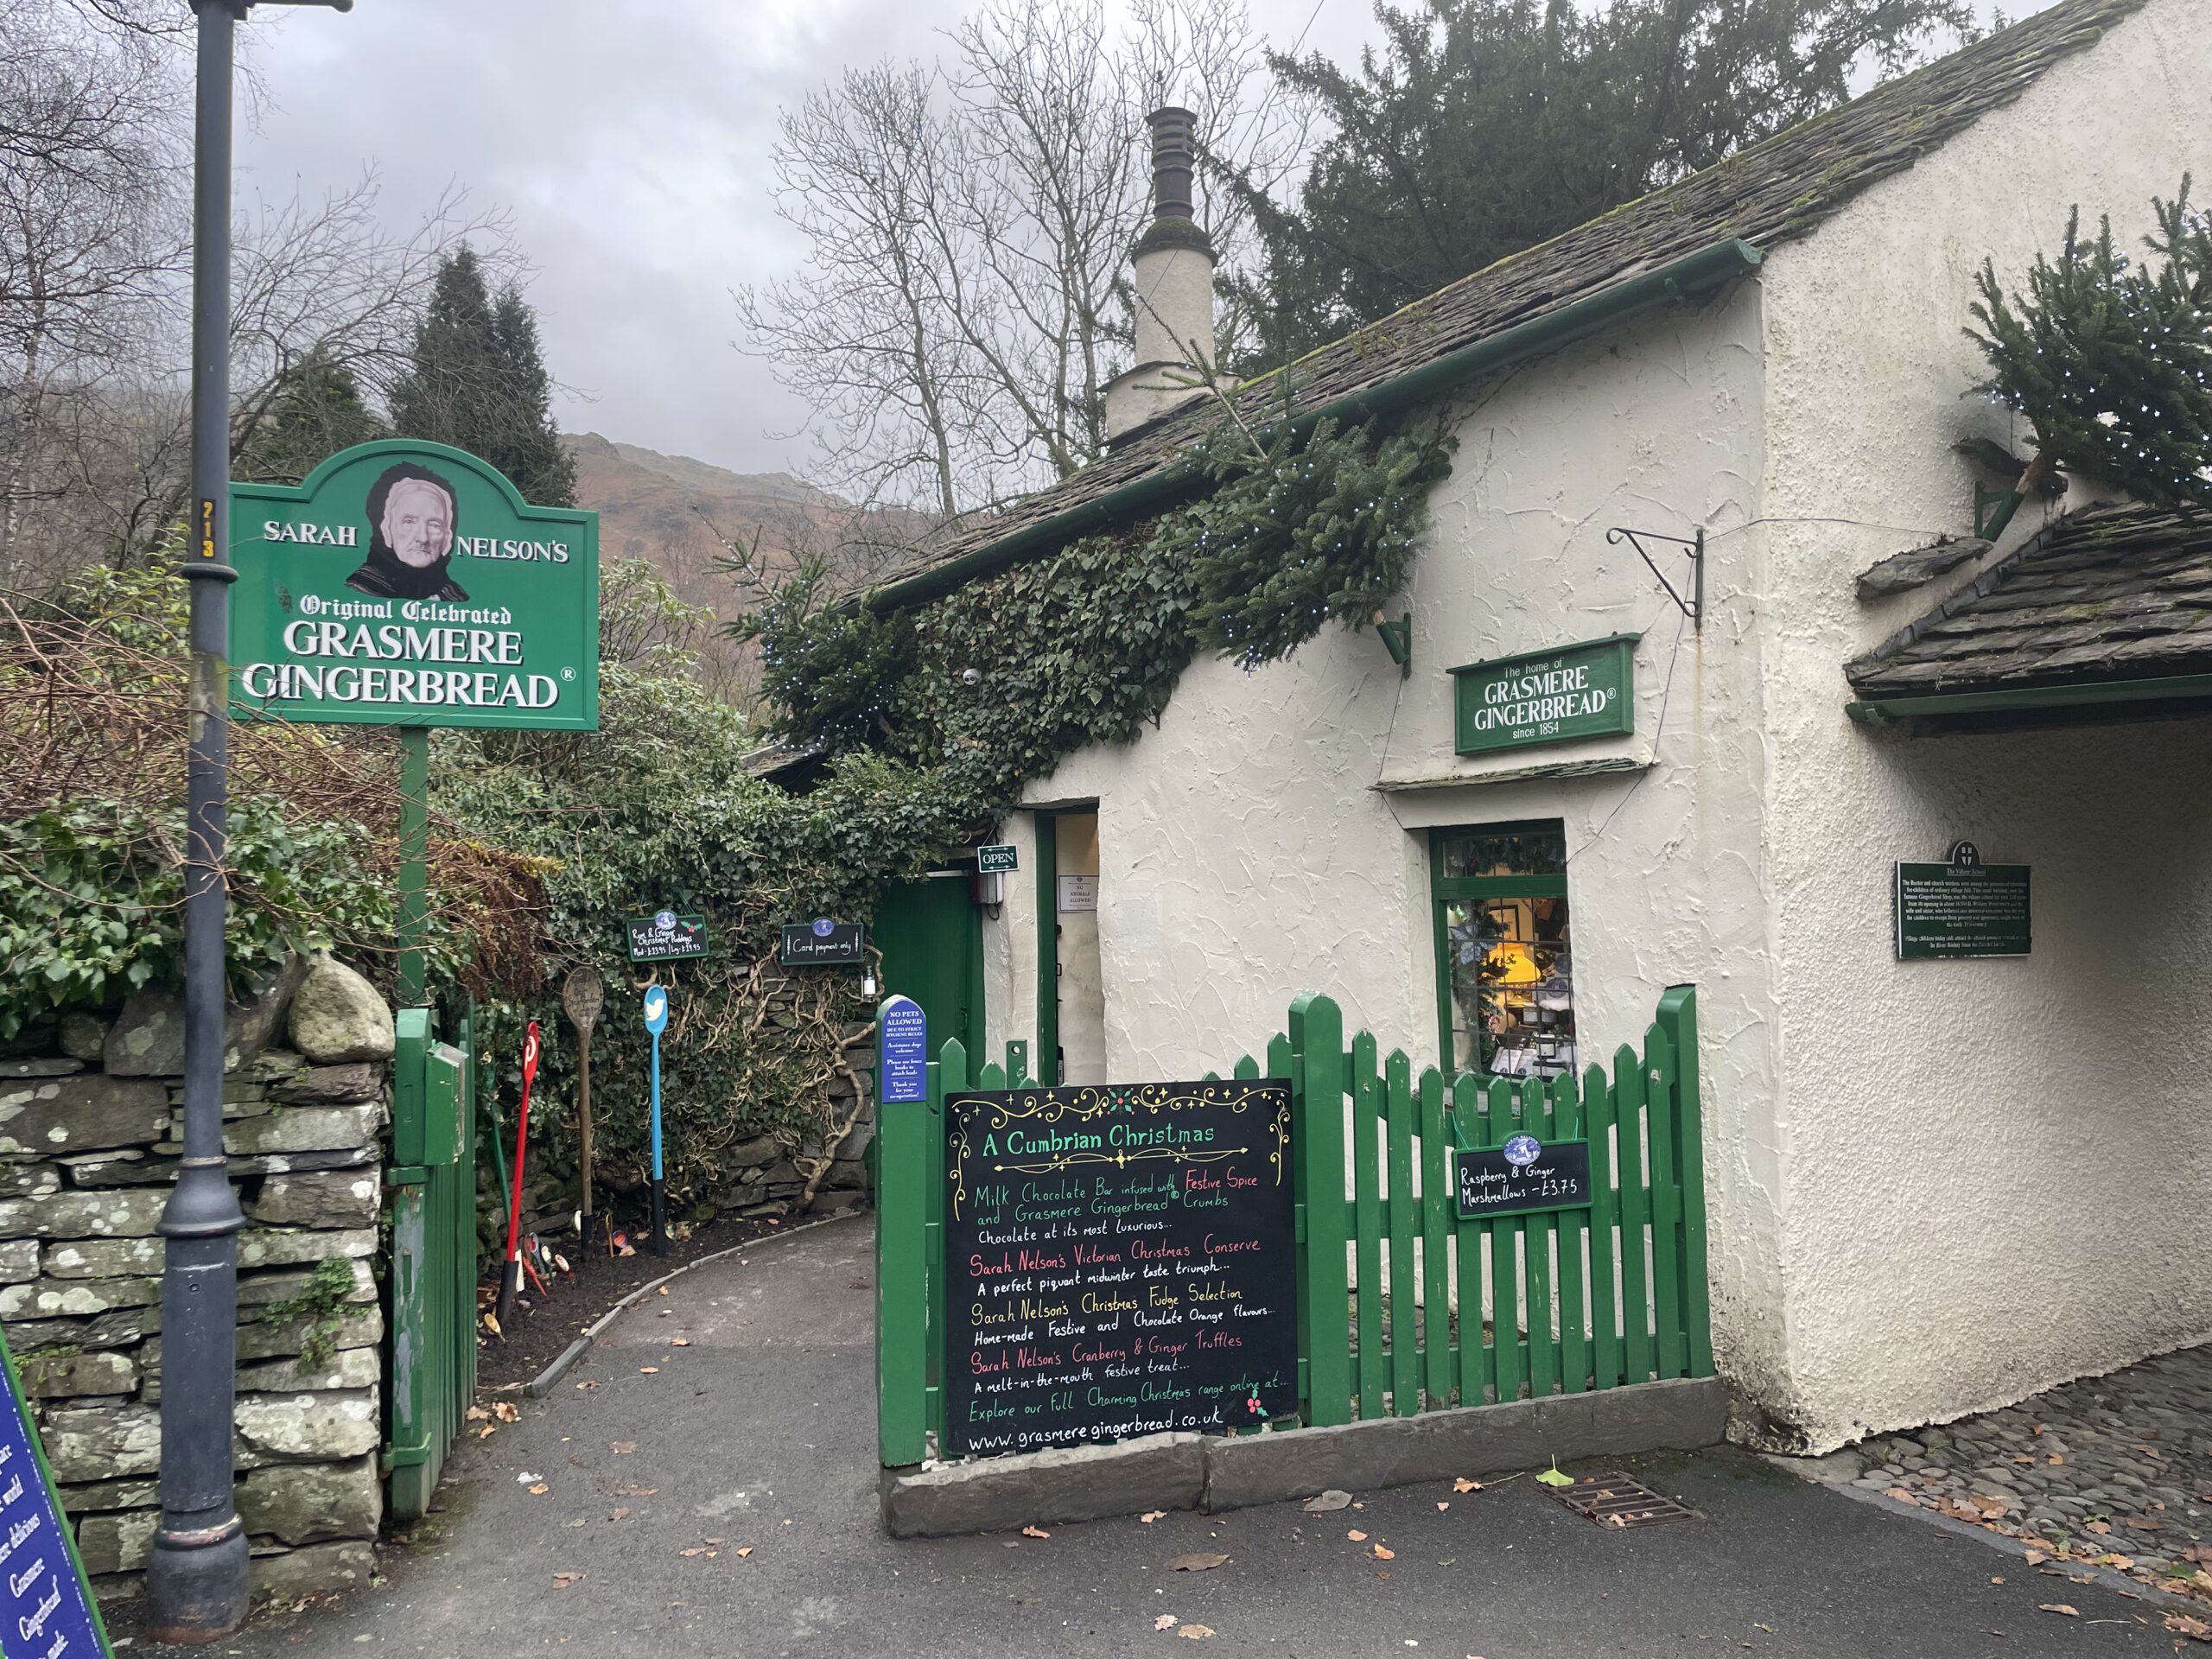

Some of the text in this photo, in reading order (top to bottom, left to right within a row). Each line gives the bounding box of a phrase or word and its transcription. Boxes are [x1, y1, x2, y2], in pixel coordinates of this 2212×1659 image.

[200, 500, 215, 558] 213
[264, 520, 569, 565] SARAH NELSON'S
[299, 594, 512, 626] Original Celebrated
[283, 620, 523, 665] GRASMERE
[1484, 665, 1590, 705] GRASMERE
[1503, 657, 1565, 679] The home of
[1512, 721, 1559, 739] since 1854
[982, 853, 1014, 864] OPEN
[648, 927, 654, 938] &
[793, 938, 851, 957] Card payment only
[982, 1122, 1214, 1157] A Cumbrian Christmas
[975, 1166, 1258, 1208] Milk Chocolate Bar infused with Festive Spice
[1460, 1164, 1555, 1186] Raspberry & Ginger
[977, 1206, 1000, 1226] and
[1015, 1204, 1082, 1223] Grasmere
[1183, 1189, 1229, 1208] Crumbs
[1462, 1185, 1526, 1207] Marshmallows
[978, 1225, 1038, 1244] Chocolate
[1044, 1223, 1058, 1239] at
[1063, 1222, 1077, 1237] its
[1084, 1219, 1108, 1236] most
[969, 1233, 1261, 1277] Sarah Nelson's Victorian Christmas Conserve
[977, 1282, 986, 1296] A
[994, 1276, 1033, 1297] perfect
[1039, 1269, 1081, 1293] piquant
[1087, 1267, 1136, 1284] midwinter
[1142, 1262, 1170, 1279] taste
[970, 1280, 1243, 1326] Sarah Nelson's Christmas Fudge Selection
[974, 1325, 1034, 1346] Home-made
[1048, 1318, 1086, 1338] Festive
[1097, 1312, 1120, 1332] and
[1134, 1310, 1183, 1328] Chocolate
[1189, 1307, 1224, 1324] Orange
[970, 1328, 1243, 1375] Sarah Nelson's Cranberry & Ginger Truffles
[974, 1382, 982, 1395] A
[987, 1366, 1094, 1393] melt-in-the-mouth
[1104, 1363, 1141, 1378] festive
[969, 1398, 1015, 1423] Explore
[1024, 1403, 1042, 1414] our
[1087, 1386, 1137, 1408] Charming
[1141, 1379, 1191, 1402] Christmas
[1198, 1384, 1224, 1398] range
[1230, 1372, 1260, 1391] online
[9, 1558, 45, 1599] Grasmere
